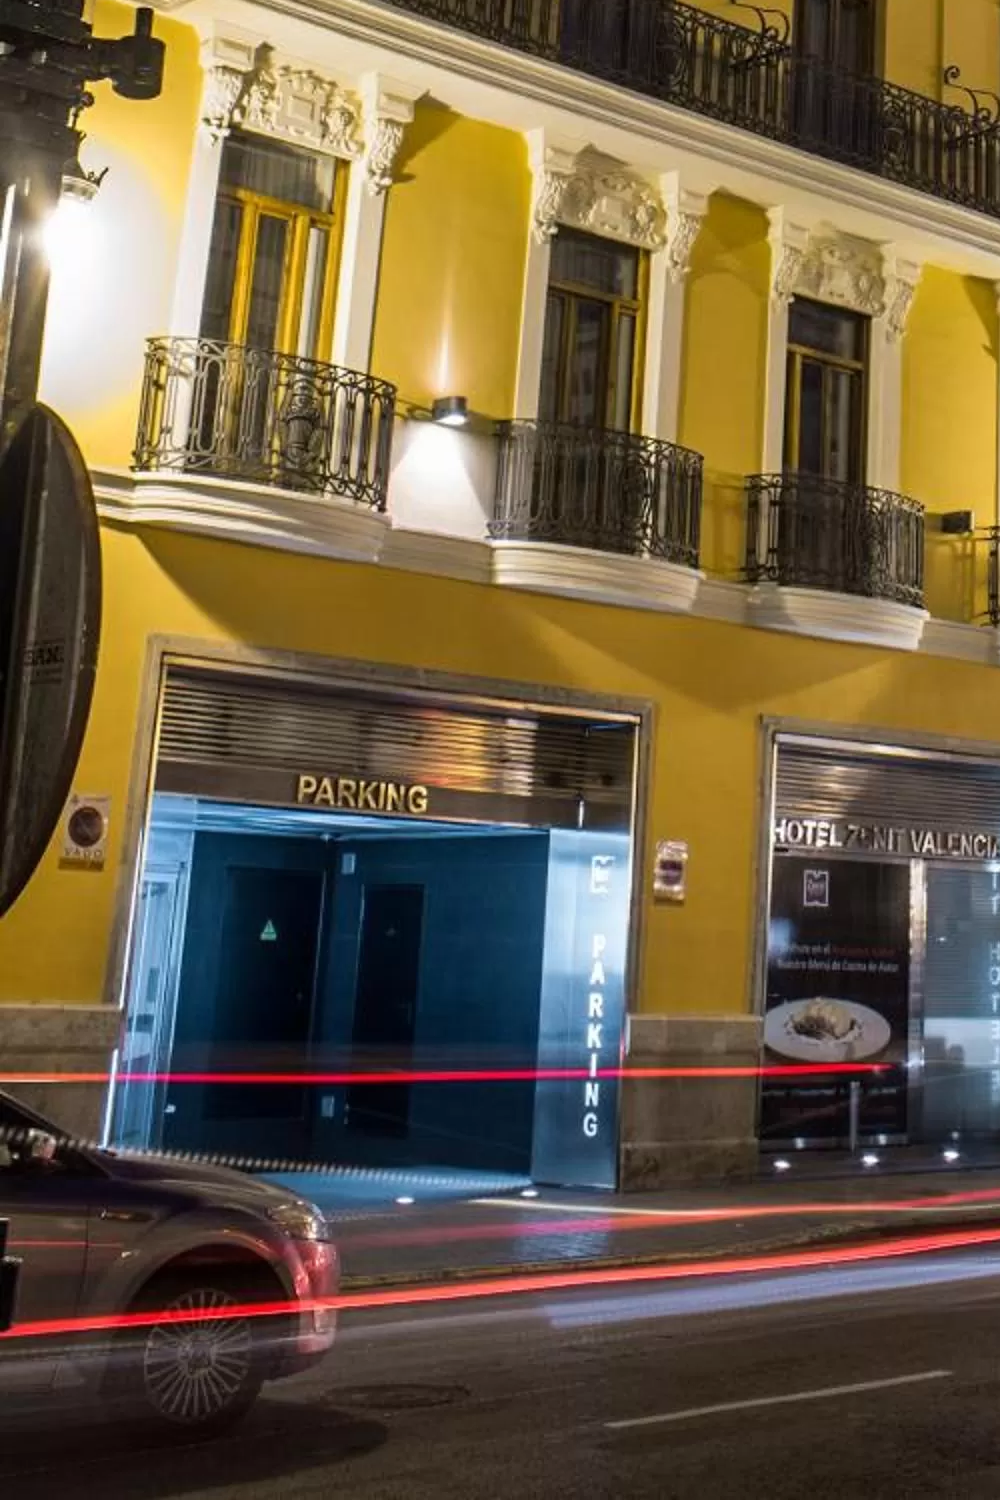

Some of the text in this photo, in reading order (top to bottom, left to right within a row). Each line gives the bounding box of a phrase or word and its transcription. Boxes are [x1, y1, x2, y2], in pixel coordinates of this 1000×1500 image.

[297, 775, 428, 813] PARKING
[773, 818, 843, 848] HOTEL
[582, 933, 607, 1138] PARKING
